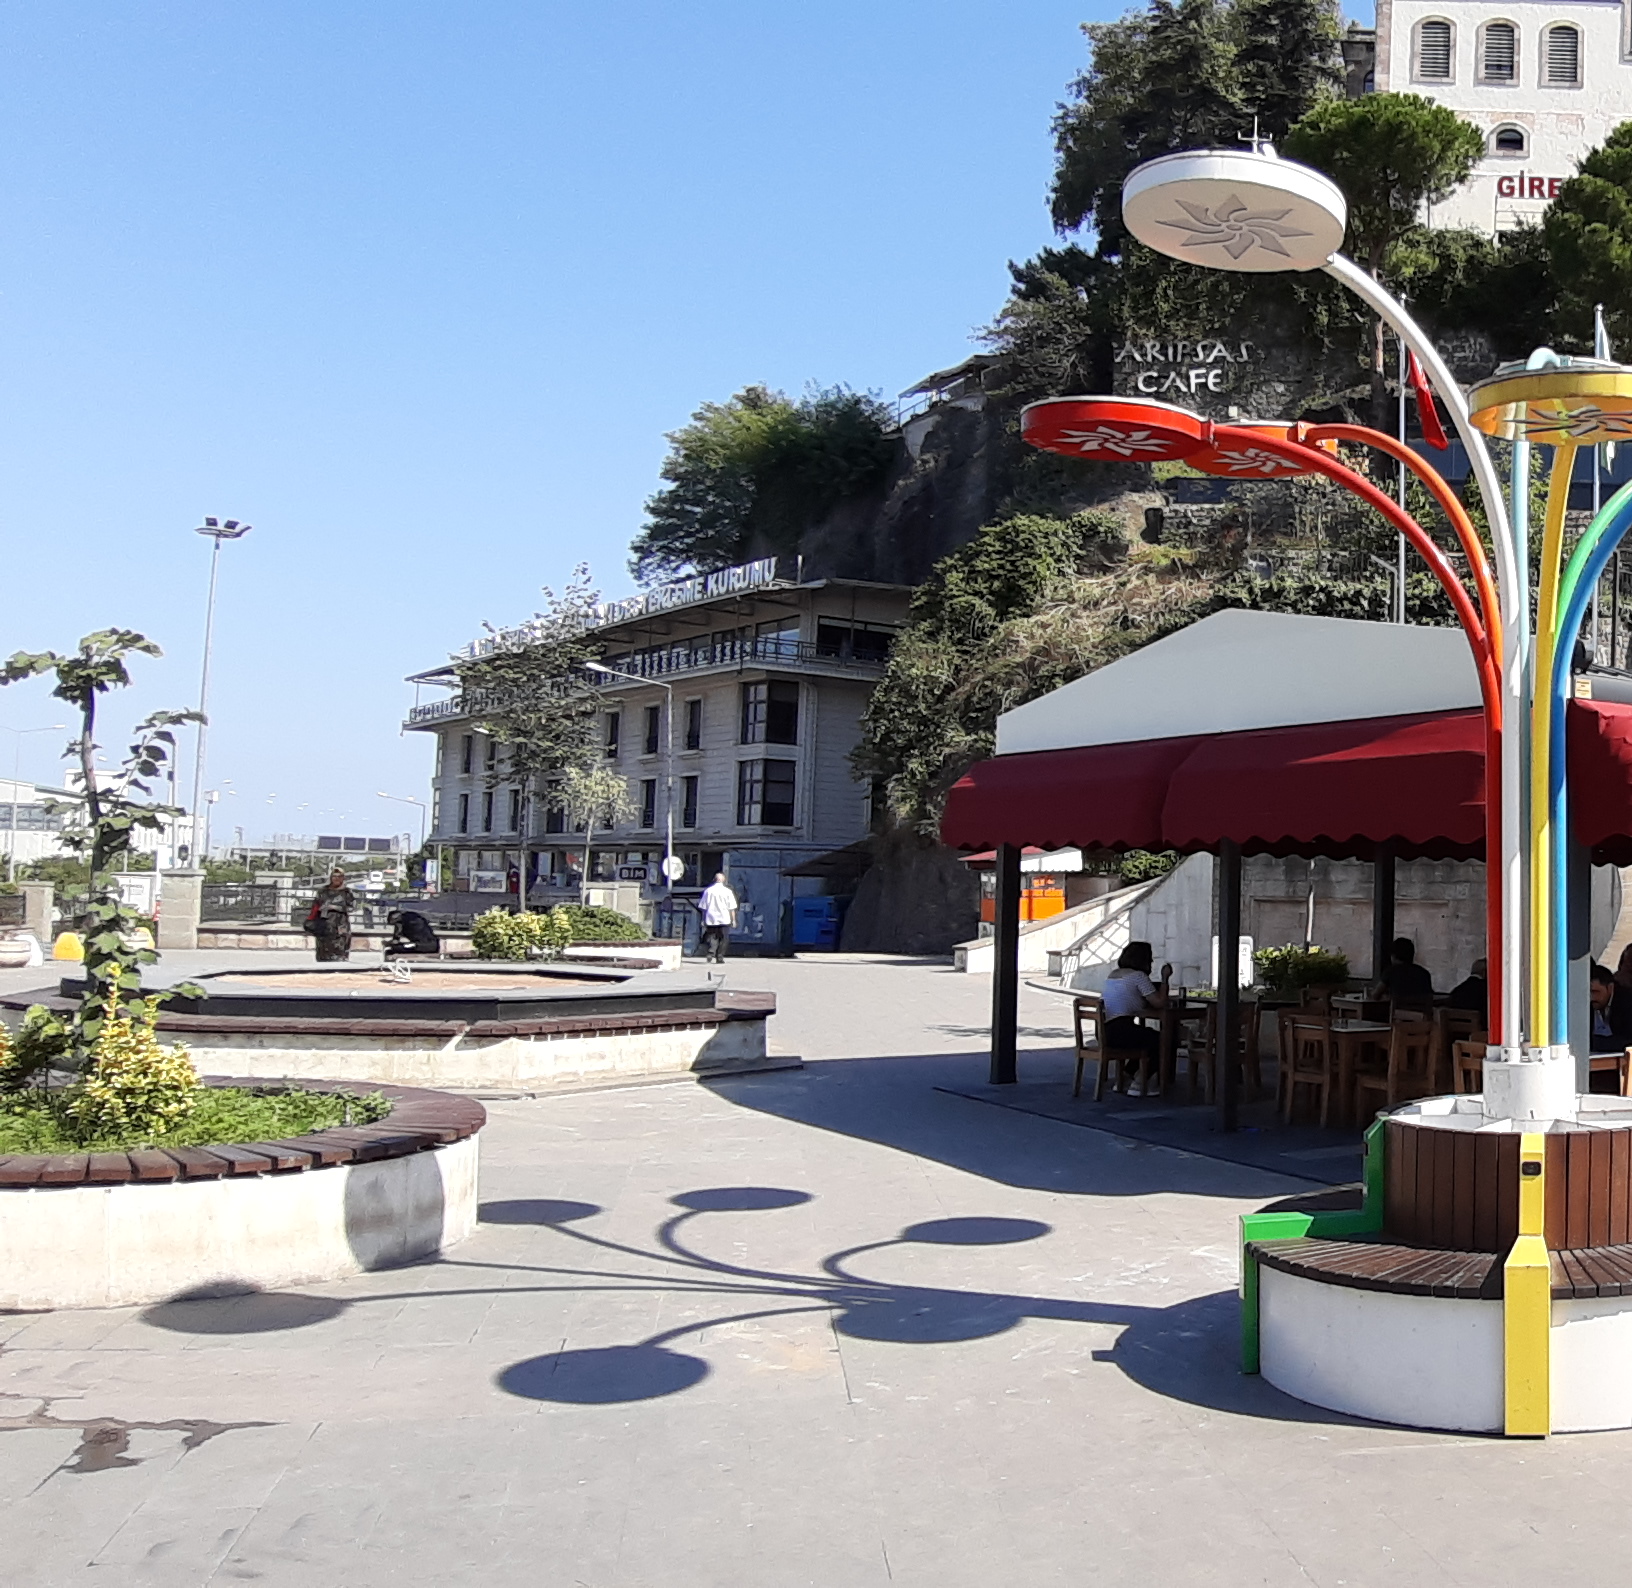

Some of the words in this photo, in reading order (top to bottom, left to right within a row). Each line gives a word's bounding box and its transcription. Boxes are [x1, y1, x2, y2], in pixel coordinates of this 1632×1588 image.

[1497, 169, 1563, 199] GİRE
[1137, 368, 1222, 393] CAFE
[706, 556, 779, 598] KURUMU
